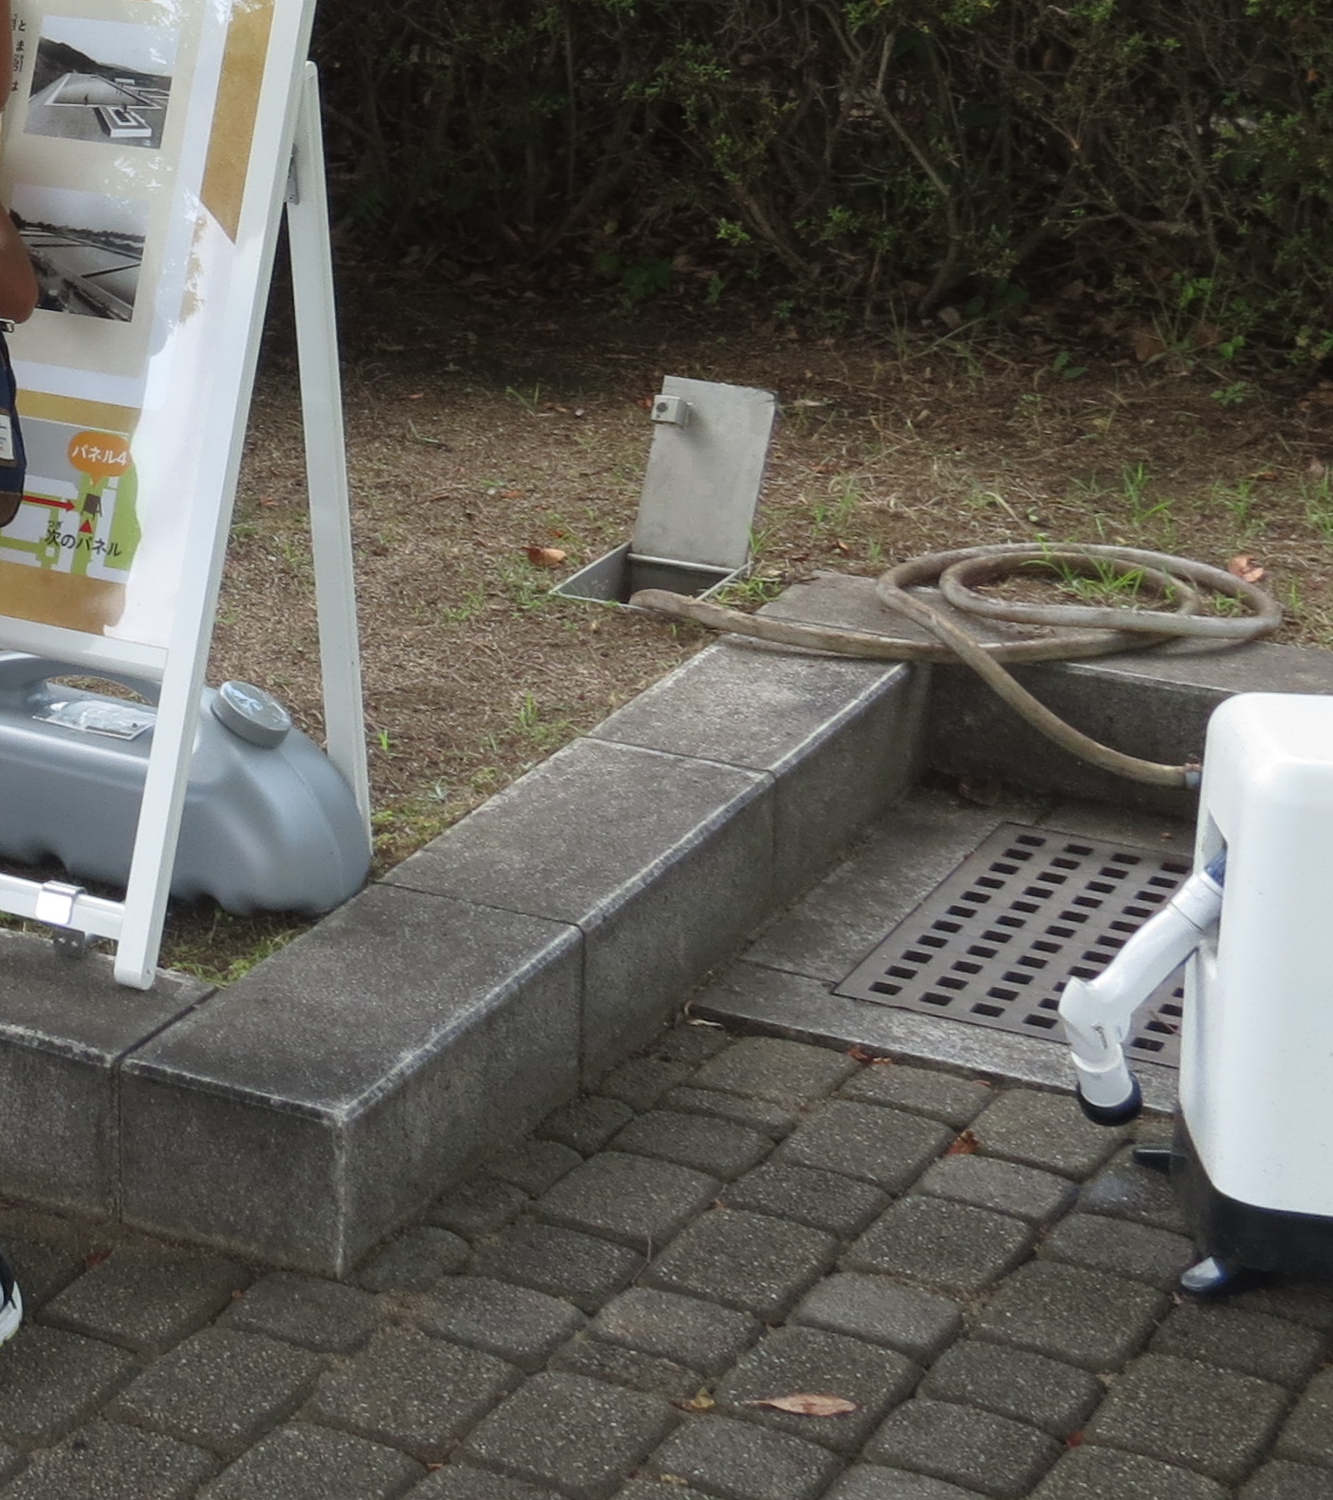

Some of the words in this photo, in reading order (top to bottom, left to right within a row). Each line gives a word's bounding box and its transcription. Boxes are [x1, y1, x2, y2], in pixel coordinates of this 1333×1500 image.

[71, 444, 128, 466] パネル4
[45, 529, 122, 557] 次のパネル
